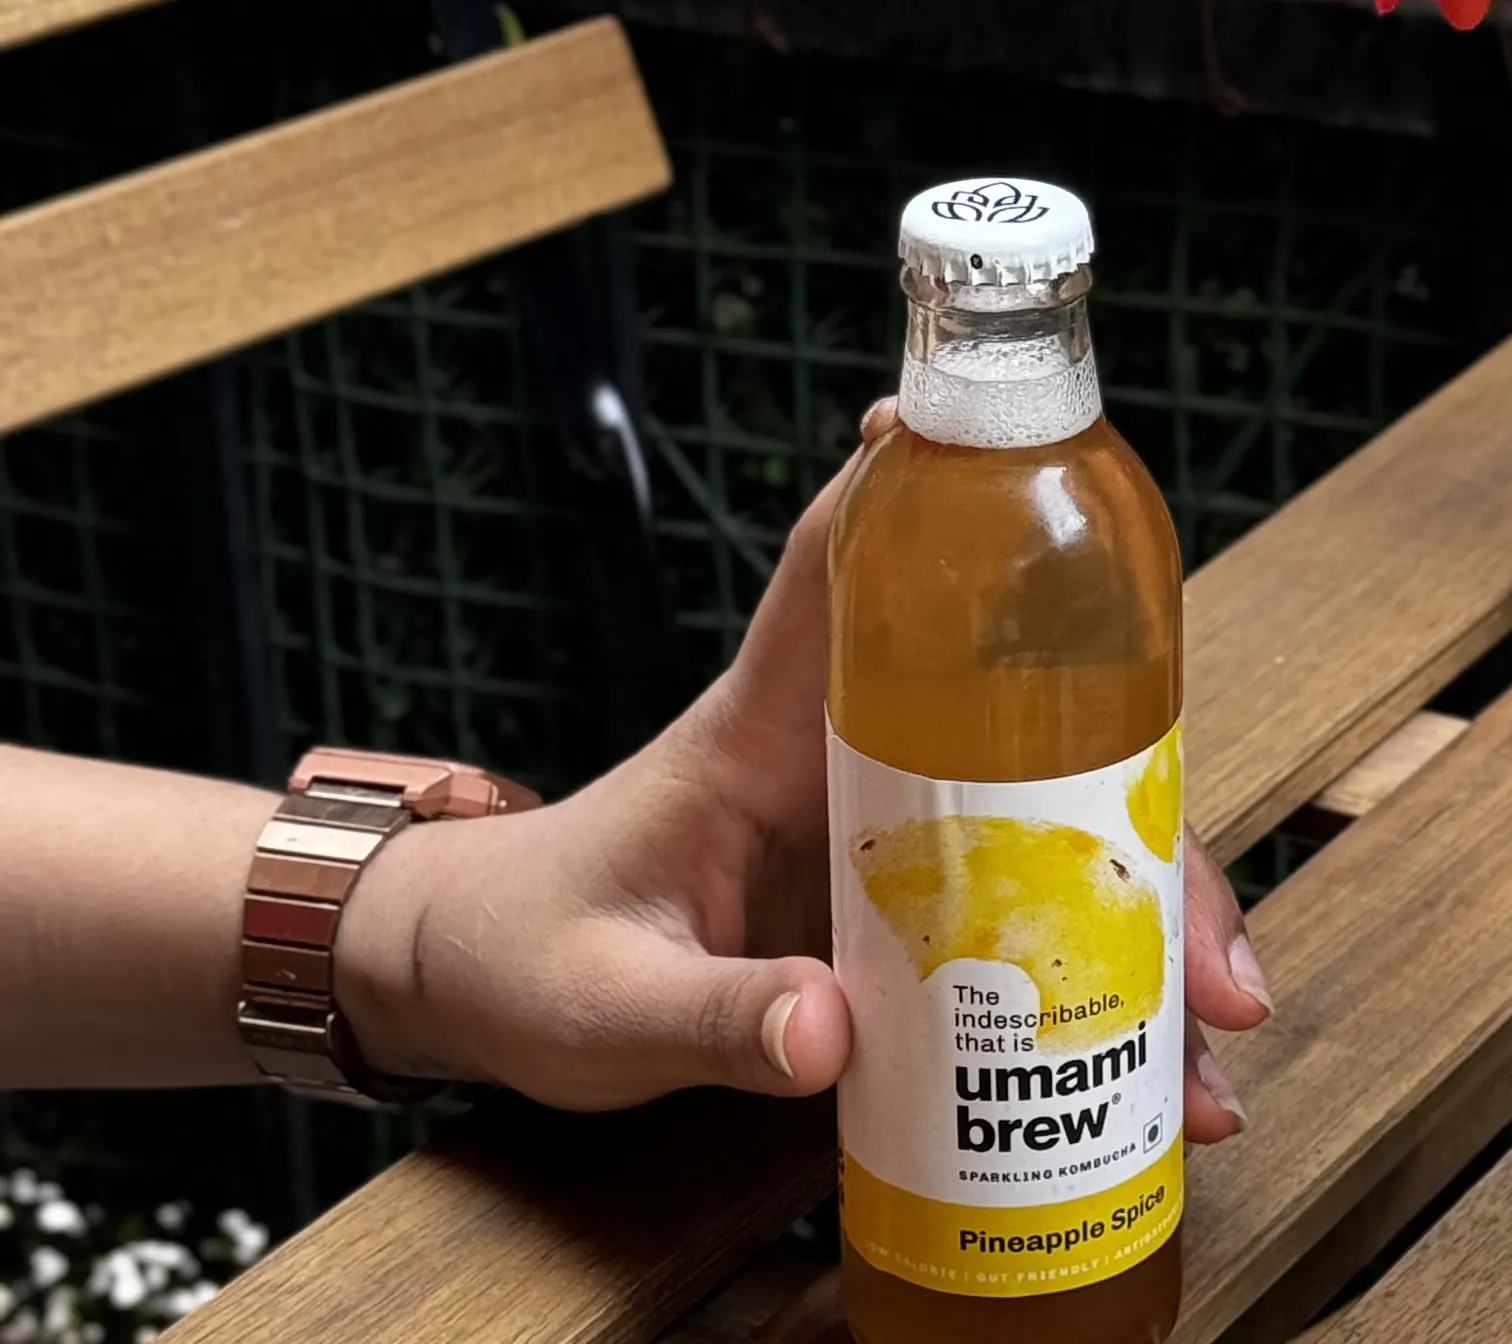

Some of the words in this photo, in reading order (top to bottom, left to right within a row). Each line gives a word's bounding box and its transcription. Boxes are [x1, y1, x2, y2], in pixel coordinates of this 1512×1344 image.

[952, 984, 1001, 1006] The
[953, 992, 1125, 1029] indescribable,
[954, 1032, 1006, 1053] that
[1013, 1032, 1035, 1053] is
[955, 1019, 1147, 1102] umami
[958, 1169, 1053, 1183] SPARKLING
[1057, 1142, 1137, 1179] KOMBUCHA
[959, 1219, 1105, 1254] Pineapple
[1110, 1184, 1166, 1231] Spice
[1016, 1258, 1101, 1284] FRIENDLY
